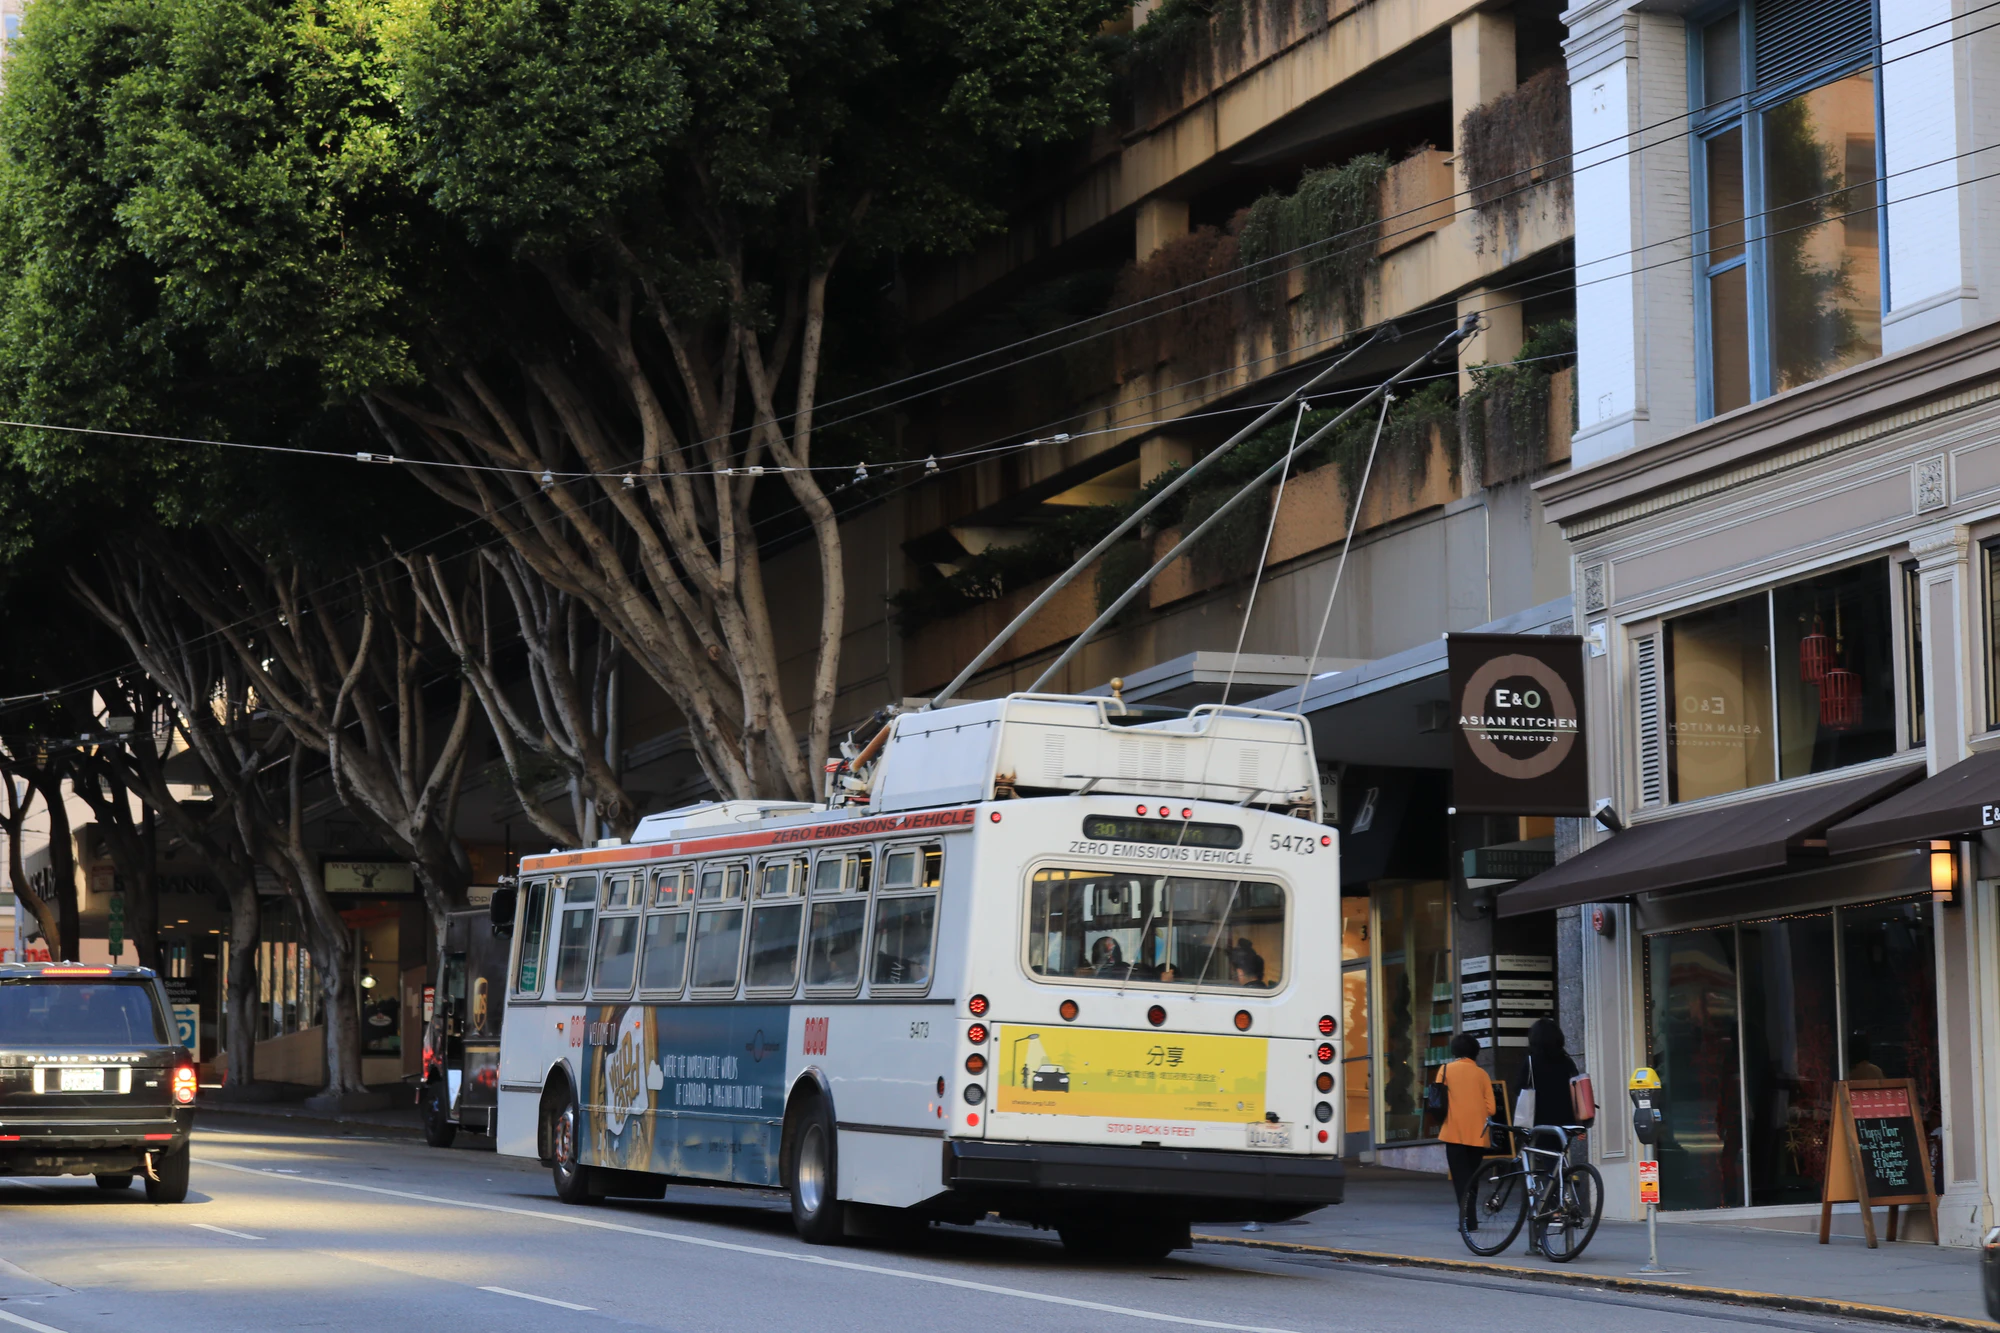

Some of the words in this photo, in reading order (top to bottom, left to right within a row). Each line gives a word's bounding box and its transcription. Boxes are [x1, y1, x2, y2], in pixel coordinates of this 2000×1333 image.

[1495, 689, 1541, 709] E&O
[1459, 716, 1506, 726] ASIAN
[1511, 717, 1578, 728] KITCHEN
[1320, 774, 1337, 786] D'S
[771, 827, 812, 844] ZERO
[815, 817, 898, 839] EMISSIONS
[903, 809, 974, 829] VEHICLE
[1068, 841, 1108, 856] ZERO
[1112, 844, 1189, 861] EMISSIONS
[1193, 849, 1253, 865] VEHICLE
[1269, 833, 1316, 855] 5473
[169, 997, 191, 1005] arage
[909, 1021, 930, 1039] 5473
[1147, 1045, 1185, 1067] 分享
[1107, 1123, 1132, 1134] STOP
[1135, 1124, 1161, 1136] BACK
[1163, 1126, 1170, 1136] 5
[1171, 1126, 1196, 1137] FEET
